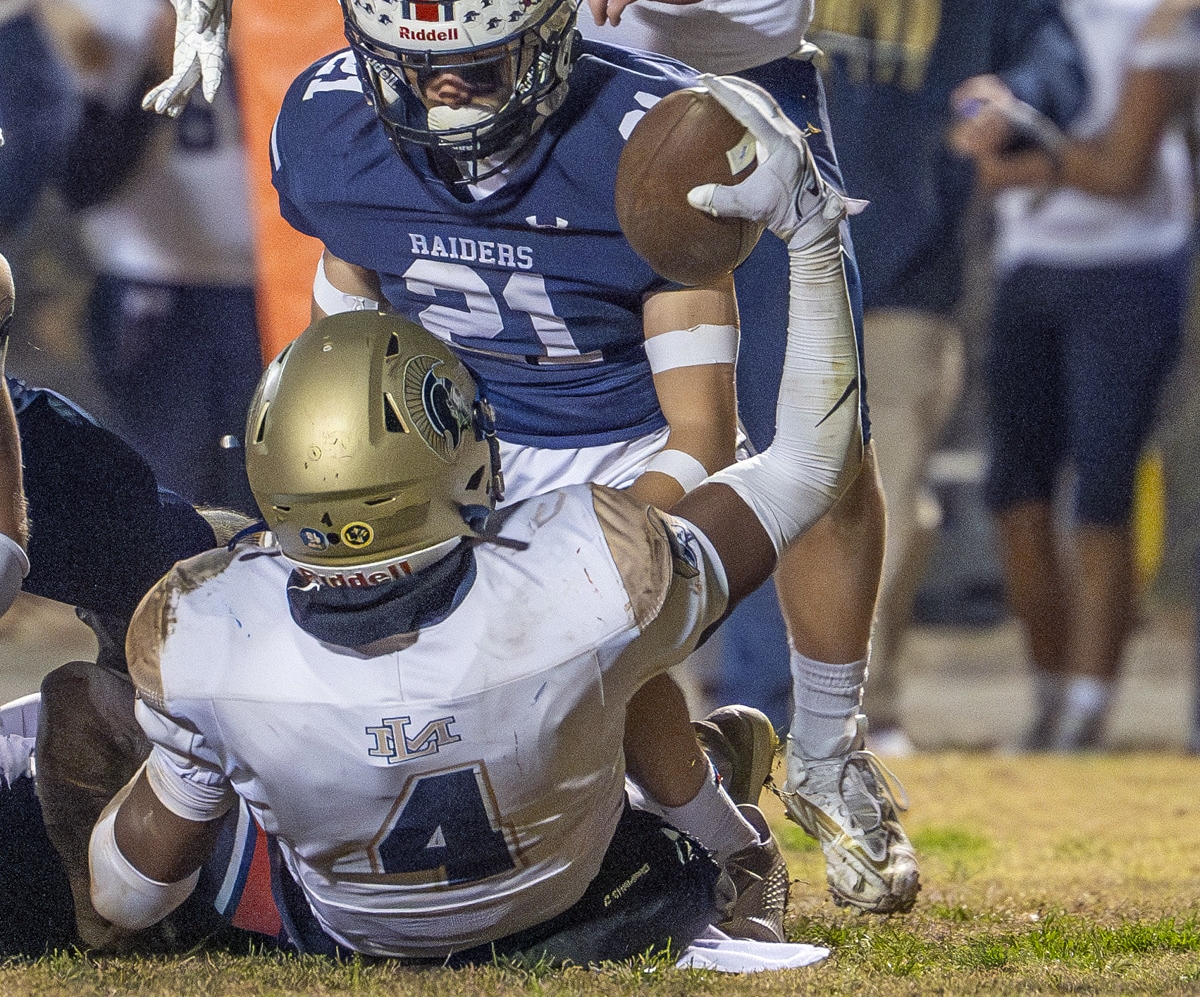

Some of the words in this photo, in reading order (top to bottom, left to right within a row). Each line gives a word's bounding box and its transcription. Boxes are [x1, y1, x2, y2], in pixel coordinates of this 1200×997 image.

[399, 26, 460, 43] Riddell
[408, 232, 534, 270] RAIDERS
[402, 258, 604, 366] 21
[366, 759, 528, 889] 4
